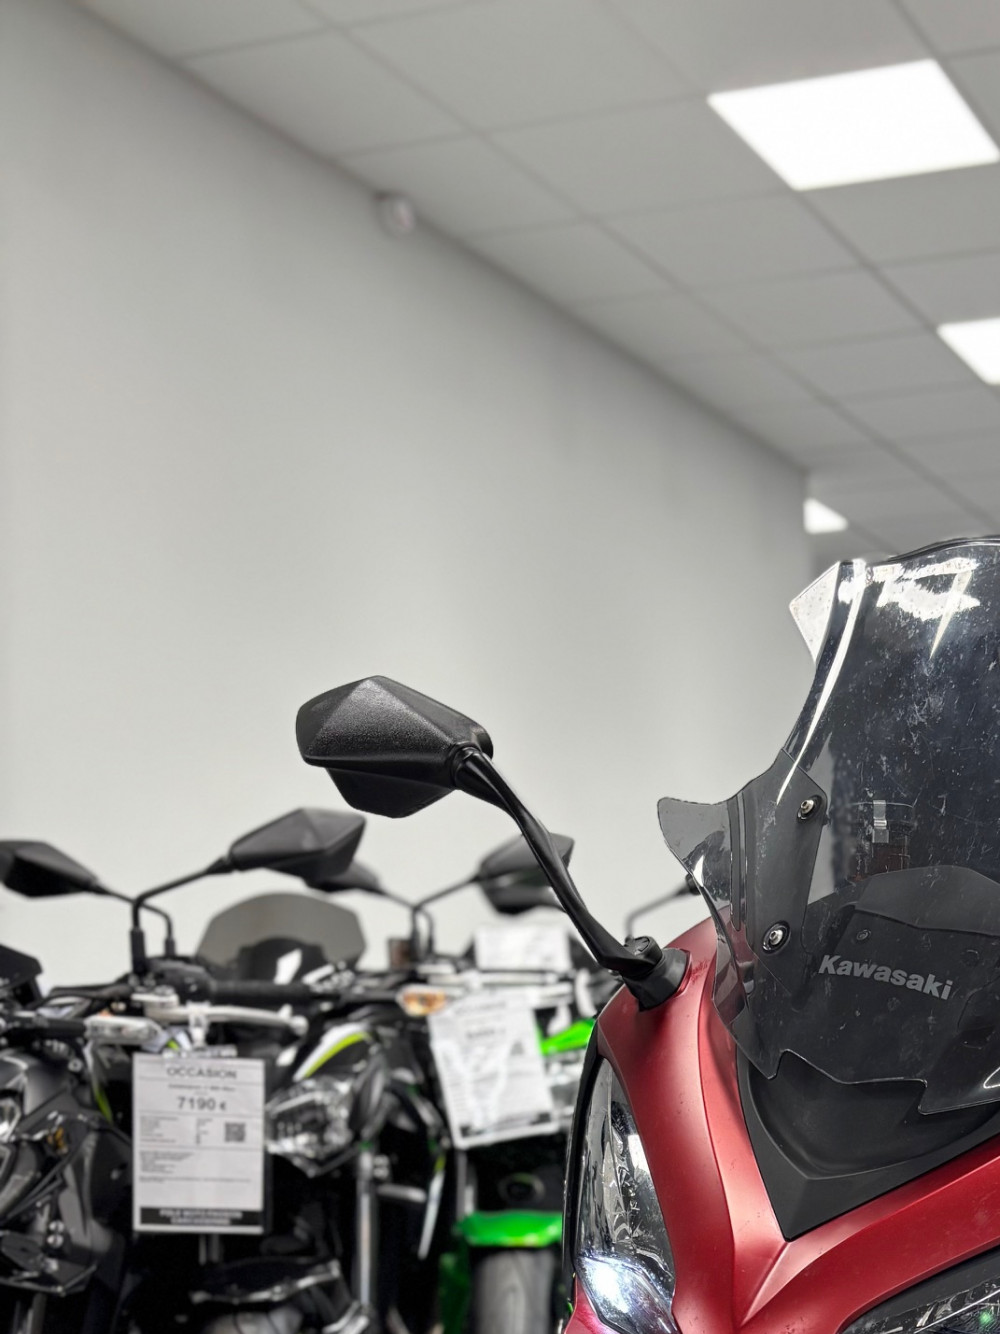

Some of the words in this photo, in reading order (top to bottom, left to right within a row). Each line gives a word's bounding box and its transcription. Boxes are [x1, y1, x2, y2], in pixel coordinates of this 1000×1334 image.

[818, 955, 953, 1000] Kawasaki
[167, 1066, 237, 1079] OCCASION
[178, 1096, 217, 1110] 7190
